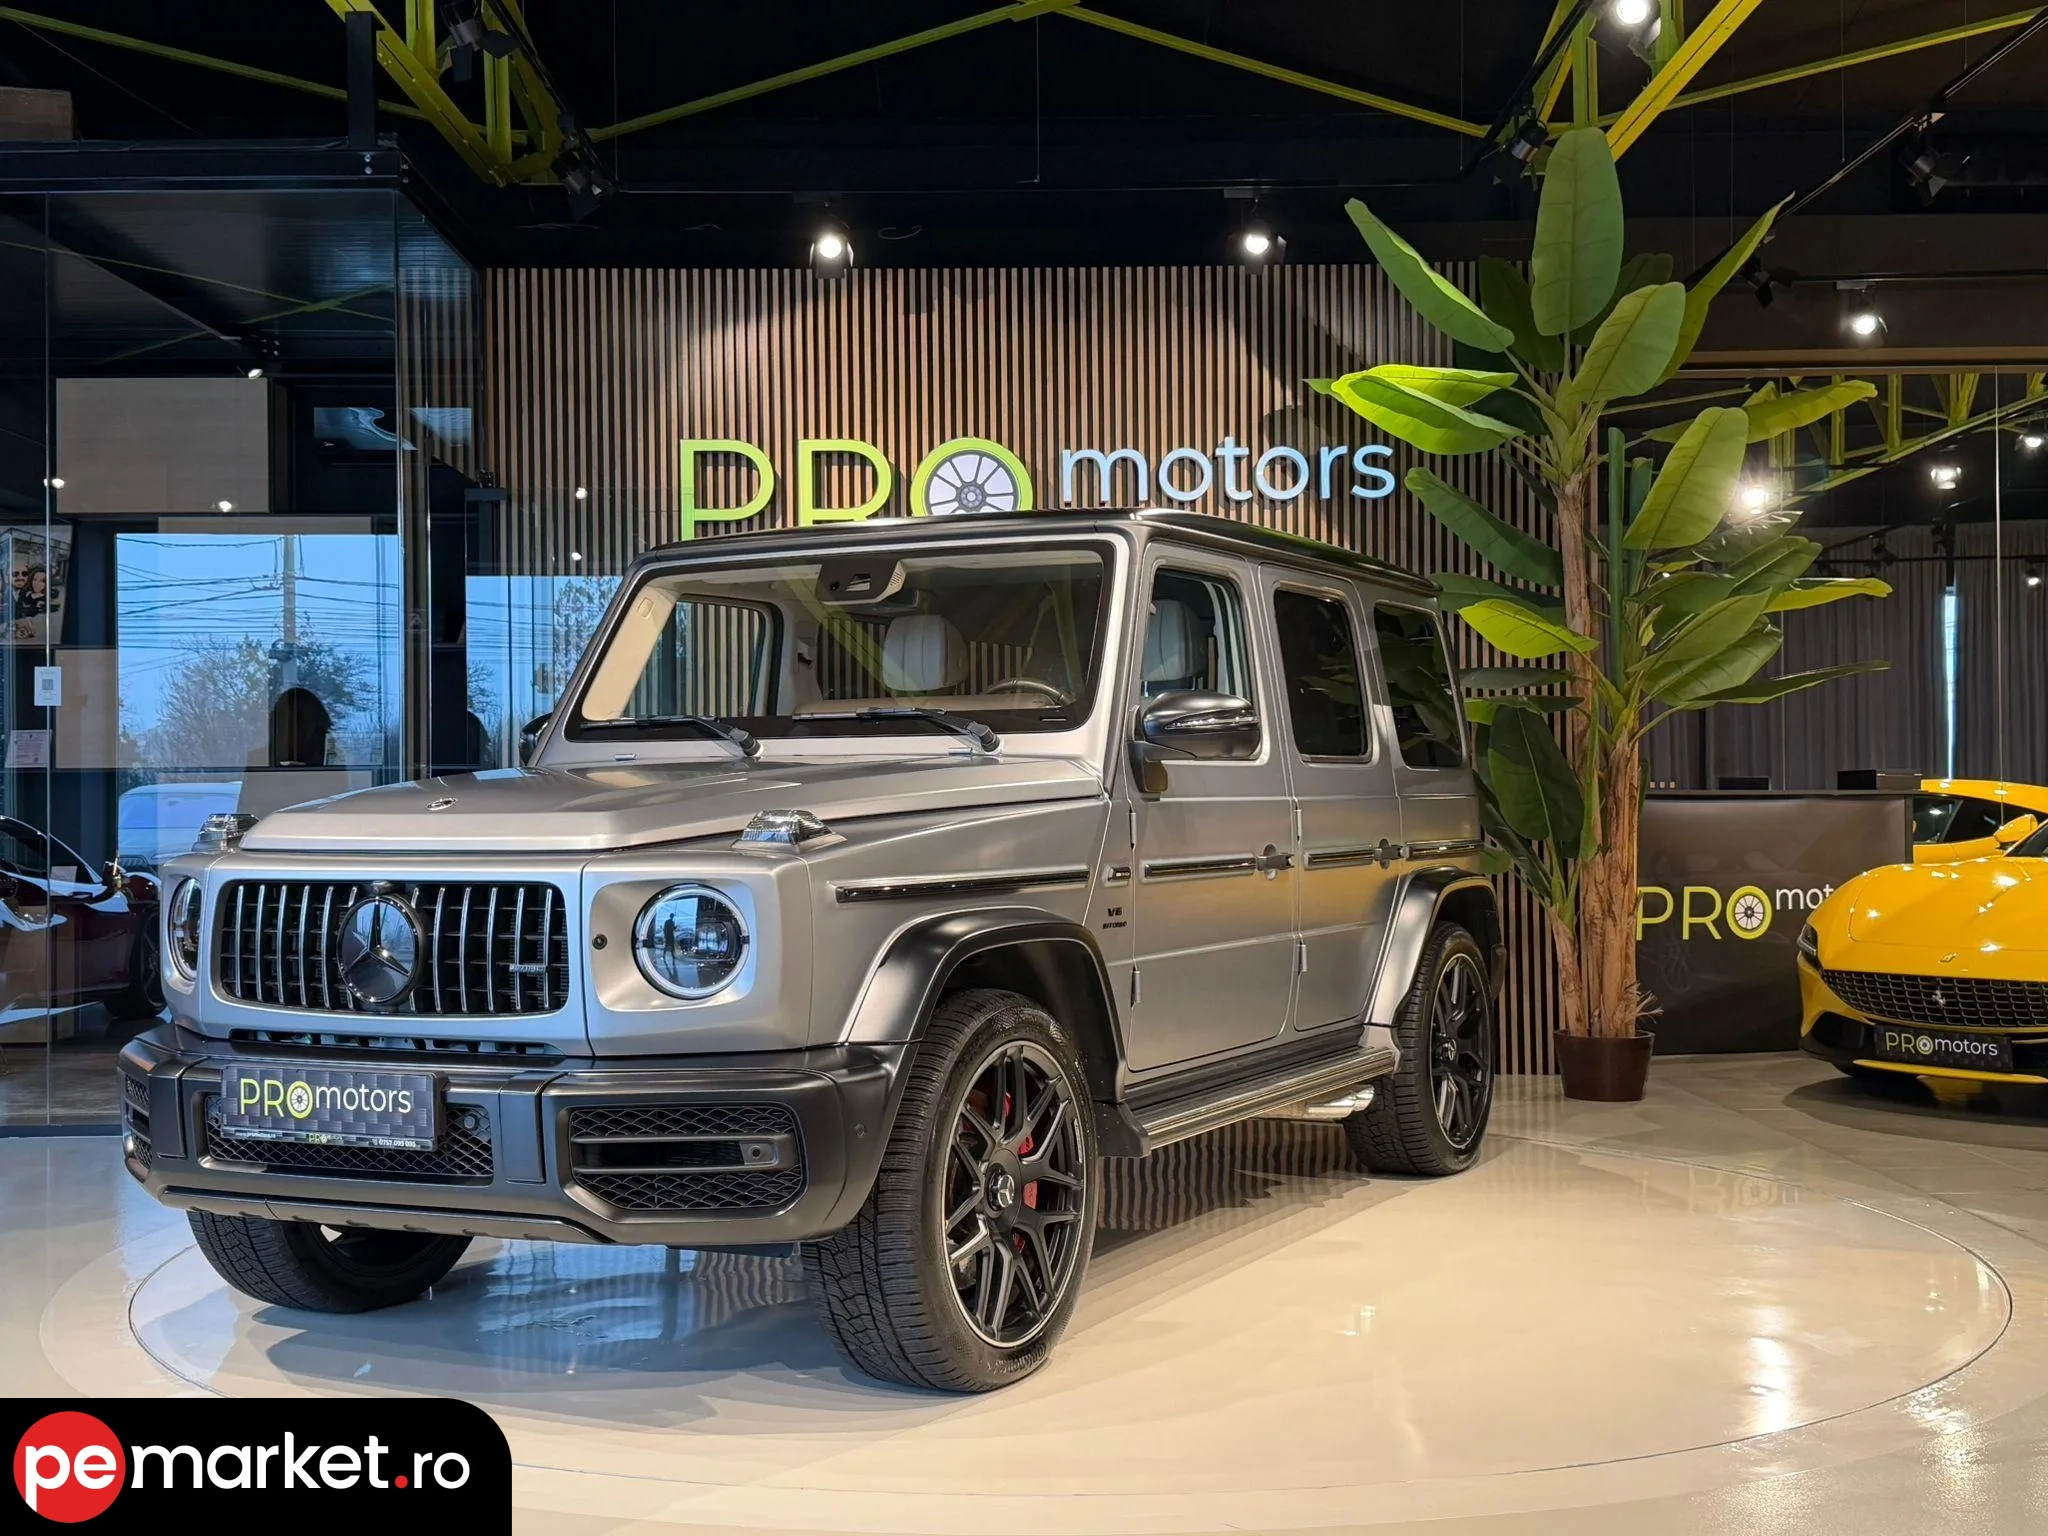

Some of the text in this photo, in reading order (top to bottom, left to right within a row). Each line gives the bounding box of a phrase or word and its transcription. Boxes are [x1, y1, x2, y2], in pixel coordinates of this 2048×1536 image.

[680, 436, 1397, 541] PRO motors
[1635, 883, 1835, 941] PROmot
